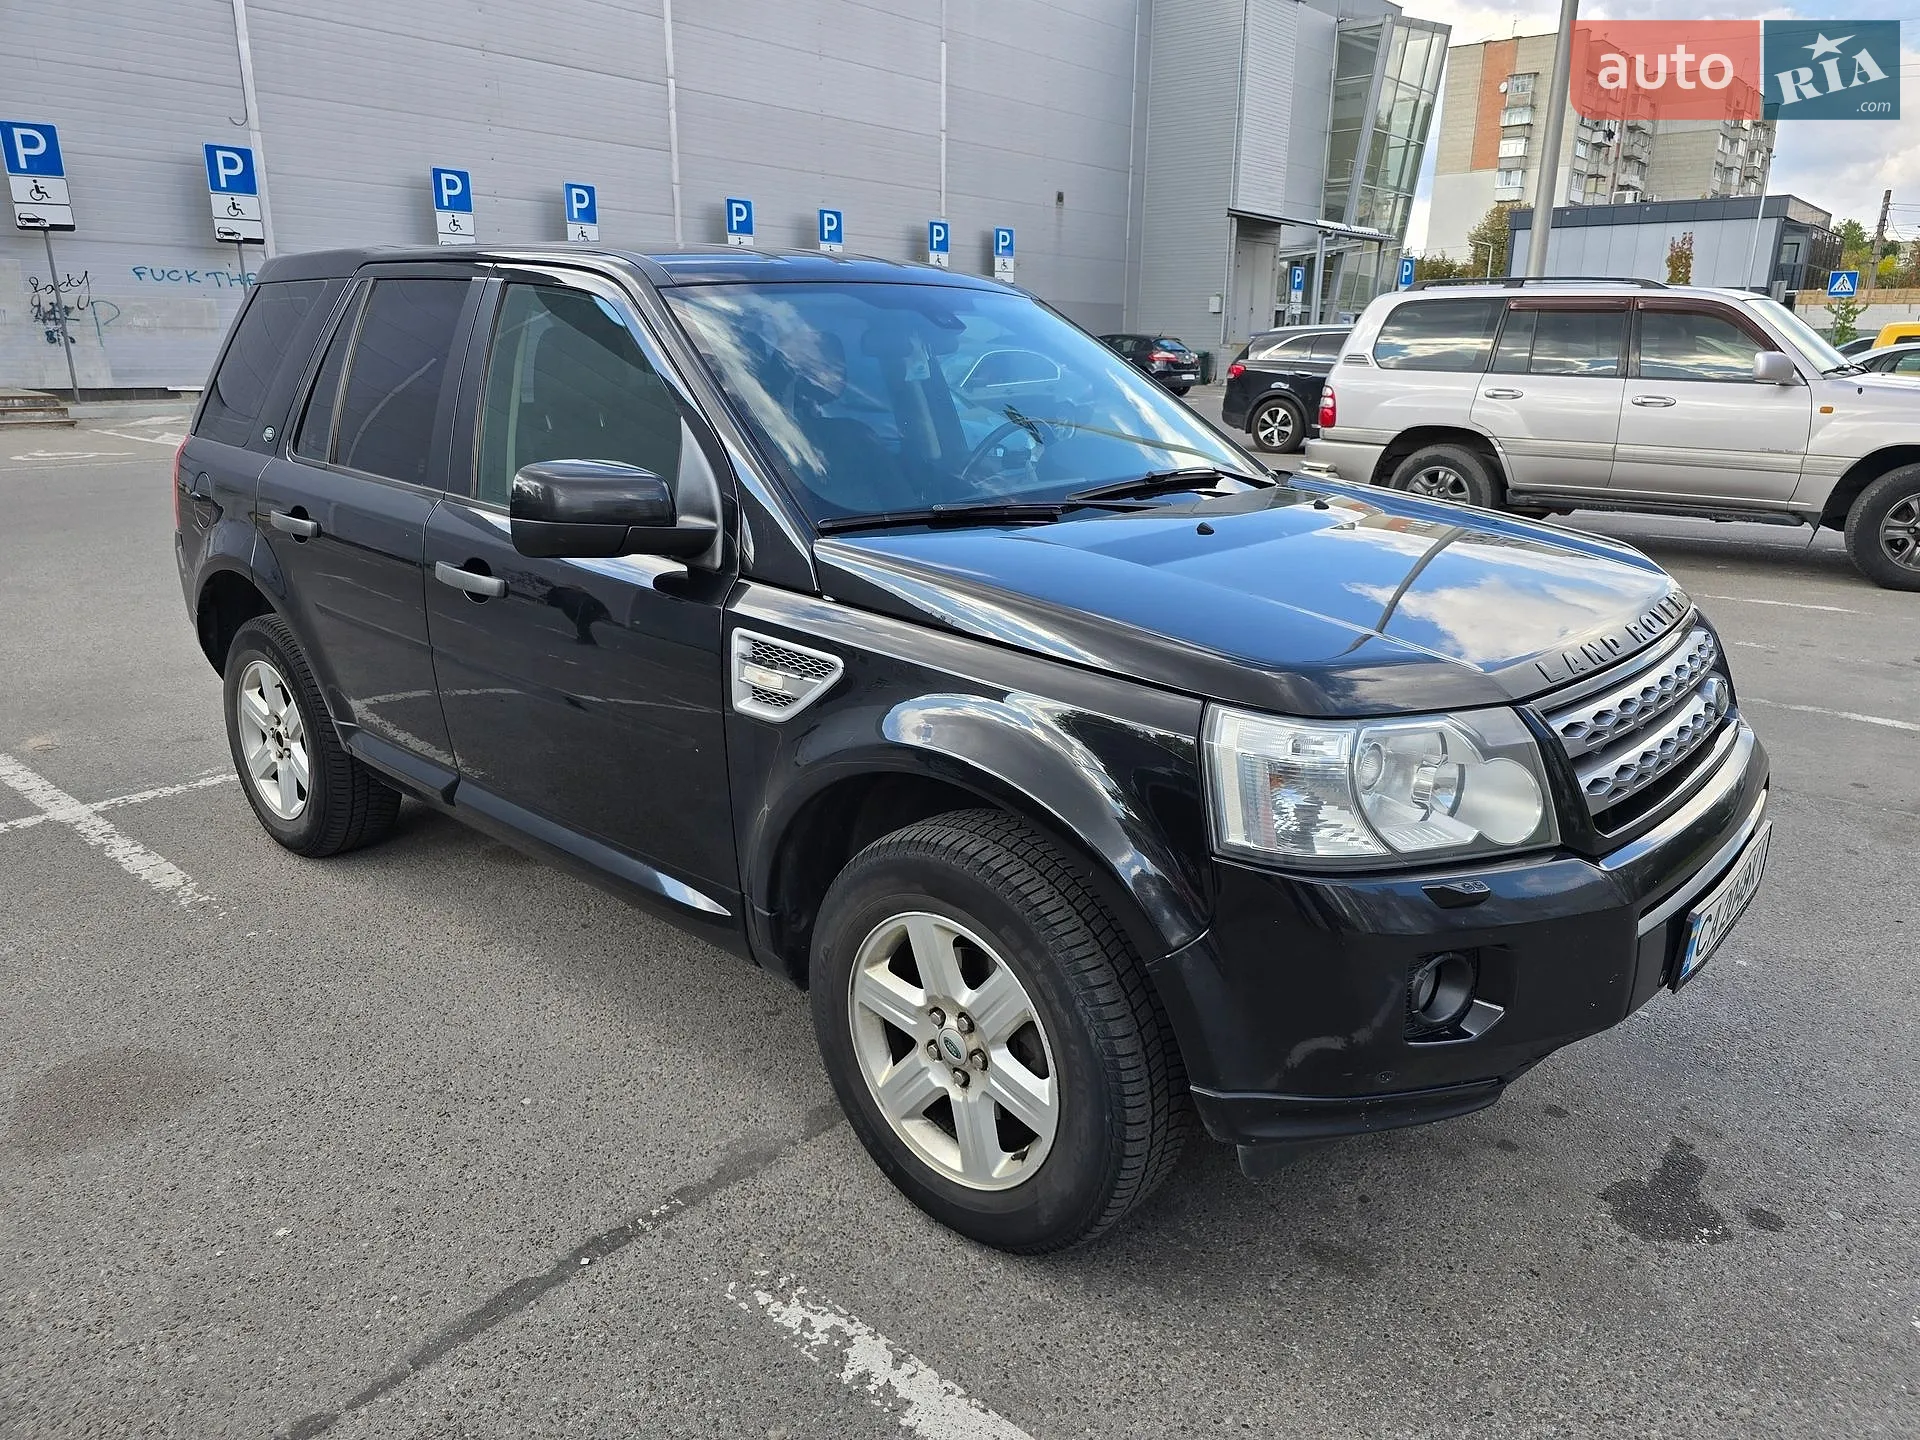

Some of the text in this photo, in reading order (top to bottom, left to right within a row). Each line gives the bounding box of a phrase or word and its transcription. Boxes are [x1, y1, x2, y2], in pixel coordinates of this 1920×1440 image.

[12, 127, 47, 169] P
[215, 150, 244, 188] P
[440, 172, 463, 207] P
[571, 188, 589, 219] P
[731, 202, 748, 231] P
[823, 212, 838, 240] P
[932, 224, 945, 249] P
[998, 230, 1011, 255] P
[132, 266, 200, 283] FUCK
[1294, 269, 1303, 289] P
[1401, 260, 1412, 283] P
[1534, 590, 1687, 683] LAND ROVER
